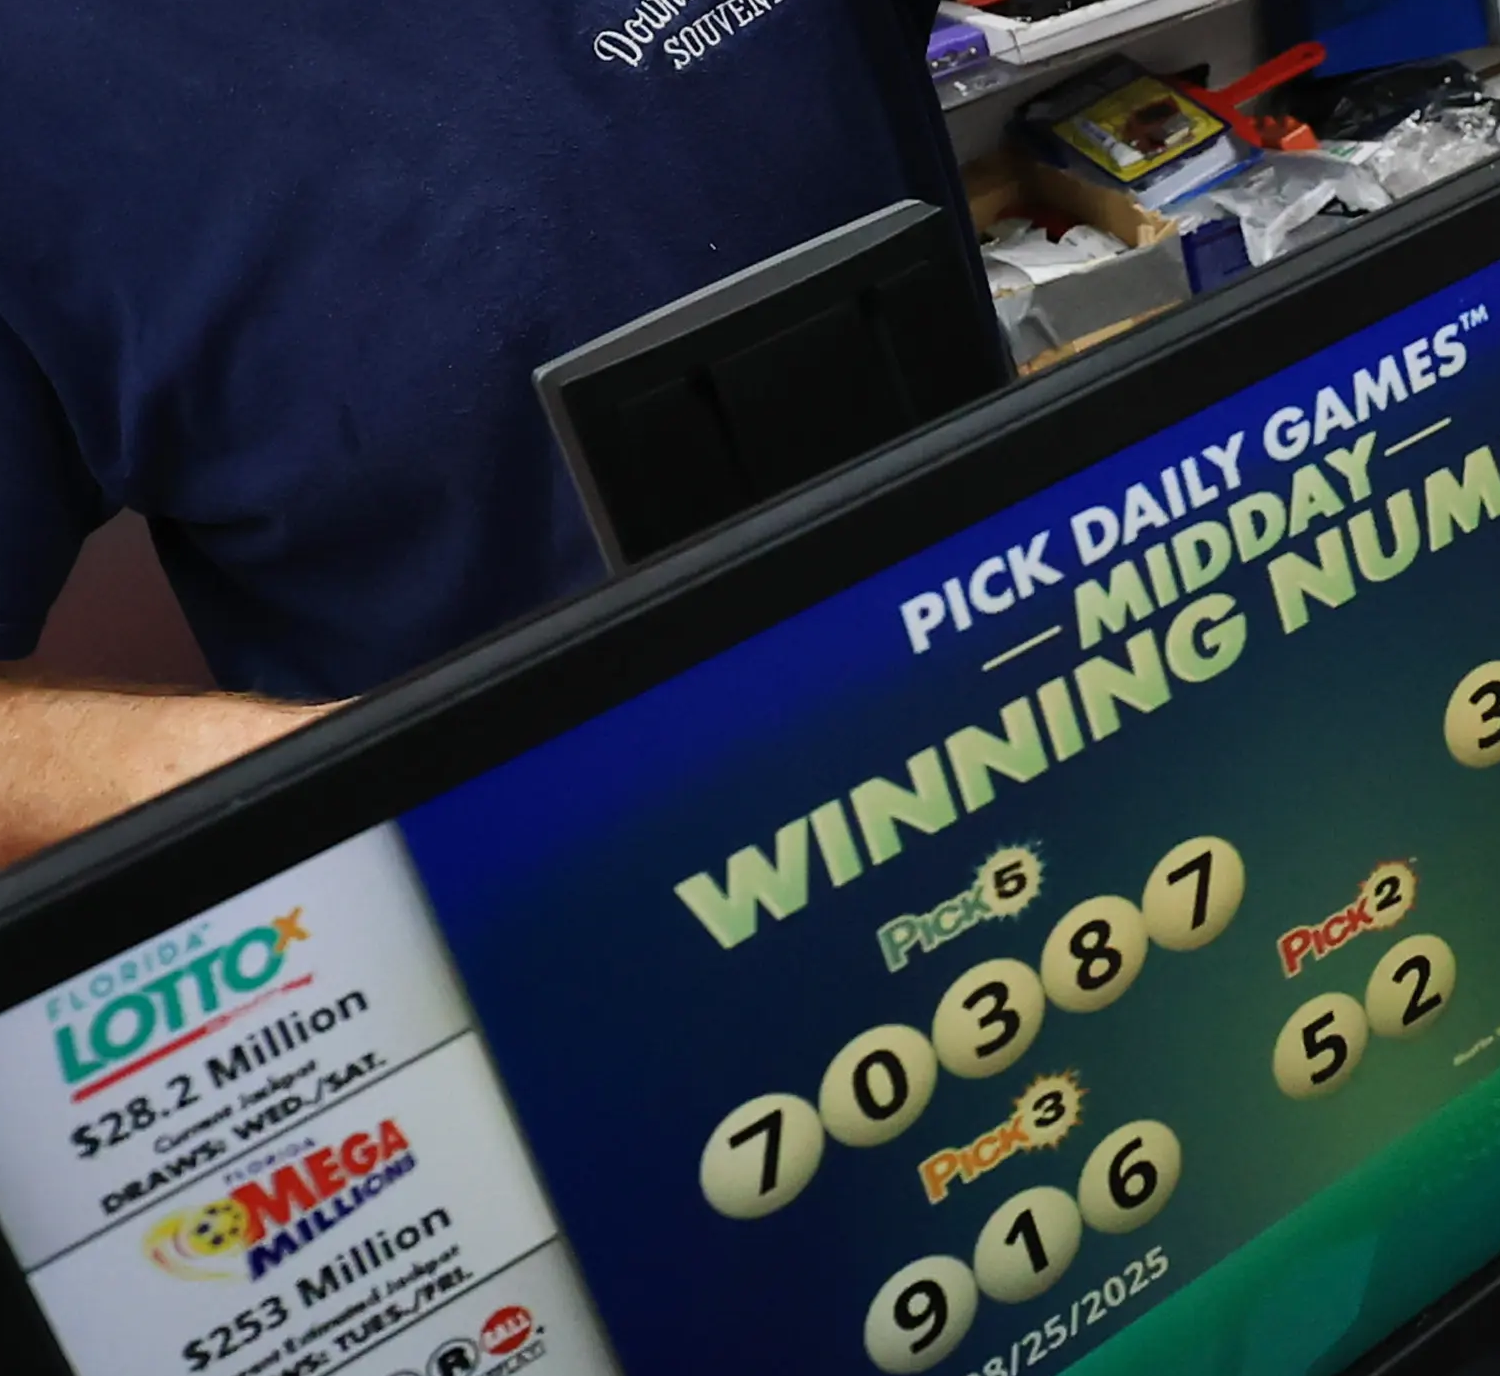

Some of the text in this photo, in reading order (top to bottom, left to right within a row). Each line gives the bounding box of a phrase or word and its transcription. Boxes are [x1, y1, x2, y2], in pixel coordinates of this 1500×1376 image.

[901, 532, 1064, 655] PICK
[1070, 432, 1243, 563] DAILY
[1075, 434, 1378, 652] MIDDAY
[676, 593, 1248, 951] WINNING
[54, 924, 283, 1087] LOTTO
[70, 987, 370, 1161] $28.2 Million
[726, 854, 1218, 1202] 7 0 3 8 7
[1301, 1009, 1351, 1082] 5
[1389, 951, 1446, 1024] 2
[100, 1139, 228, 1215] DRAWS:
[240, 1117, 411, 1228] MEGA
[247, 1153, 418, 1284] MILLIONS
[891, 1138, 1161, 1350] 9 1 6
[182, 1294, 290, 1374] $253
[296, 1206, 453, 1303] Million
